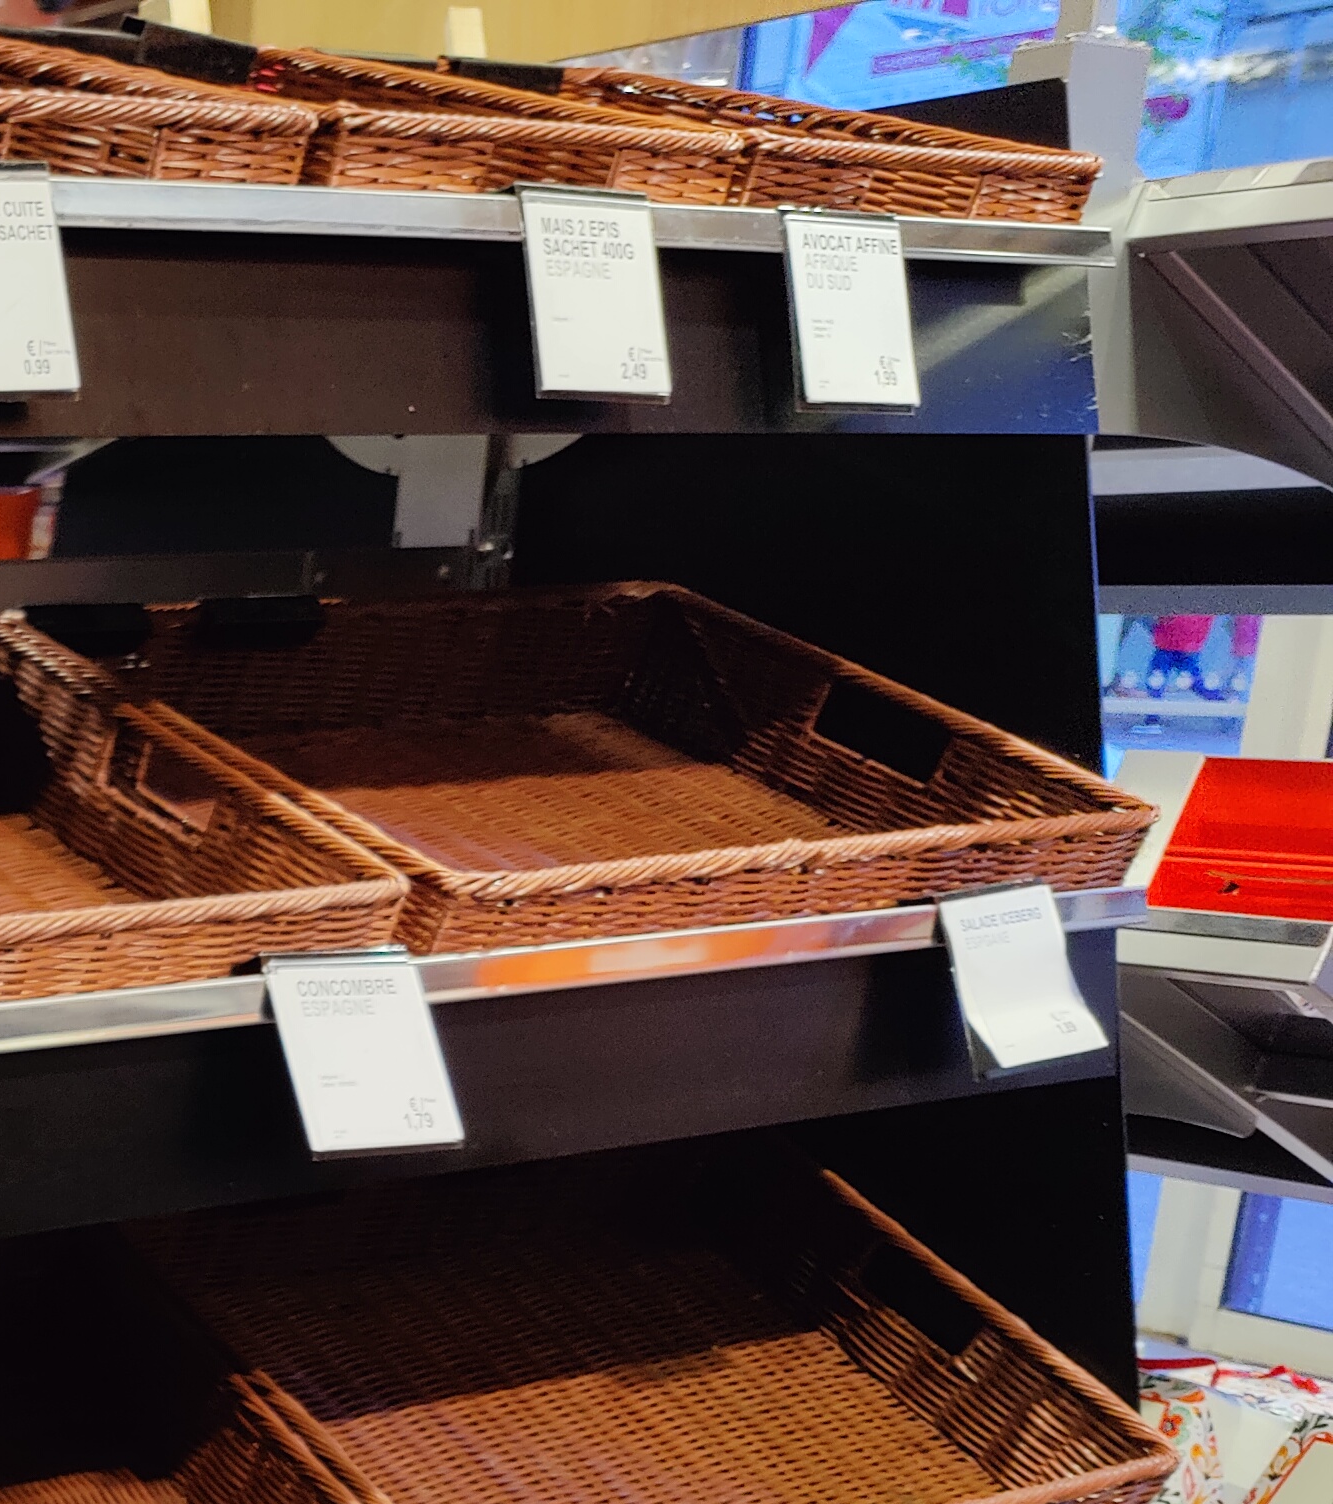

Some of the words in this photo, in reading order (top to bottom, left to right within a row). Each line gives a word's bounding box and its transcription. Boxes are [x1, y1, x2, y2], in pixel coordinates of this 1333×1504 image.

[3, 201, 45, 217] CUITE
[541, 217, 573, 236] MAIS
[578, 220, 585, 236] 2
[590, 221, 620, 238] EPIS
[543, 238, 597, 257] SACHET
[602, 243, 634, 259] 400G
[802, 233, 852, 251] AVOCAT
[856, 238, 898, 255] AFFINE
[547, 260, 612, 280] ESPAGNE
[297, 979, 397, 997] CONCOMBRE
[301, 999, 375, 1017] ESPAGNE
